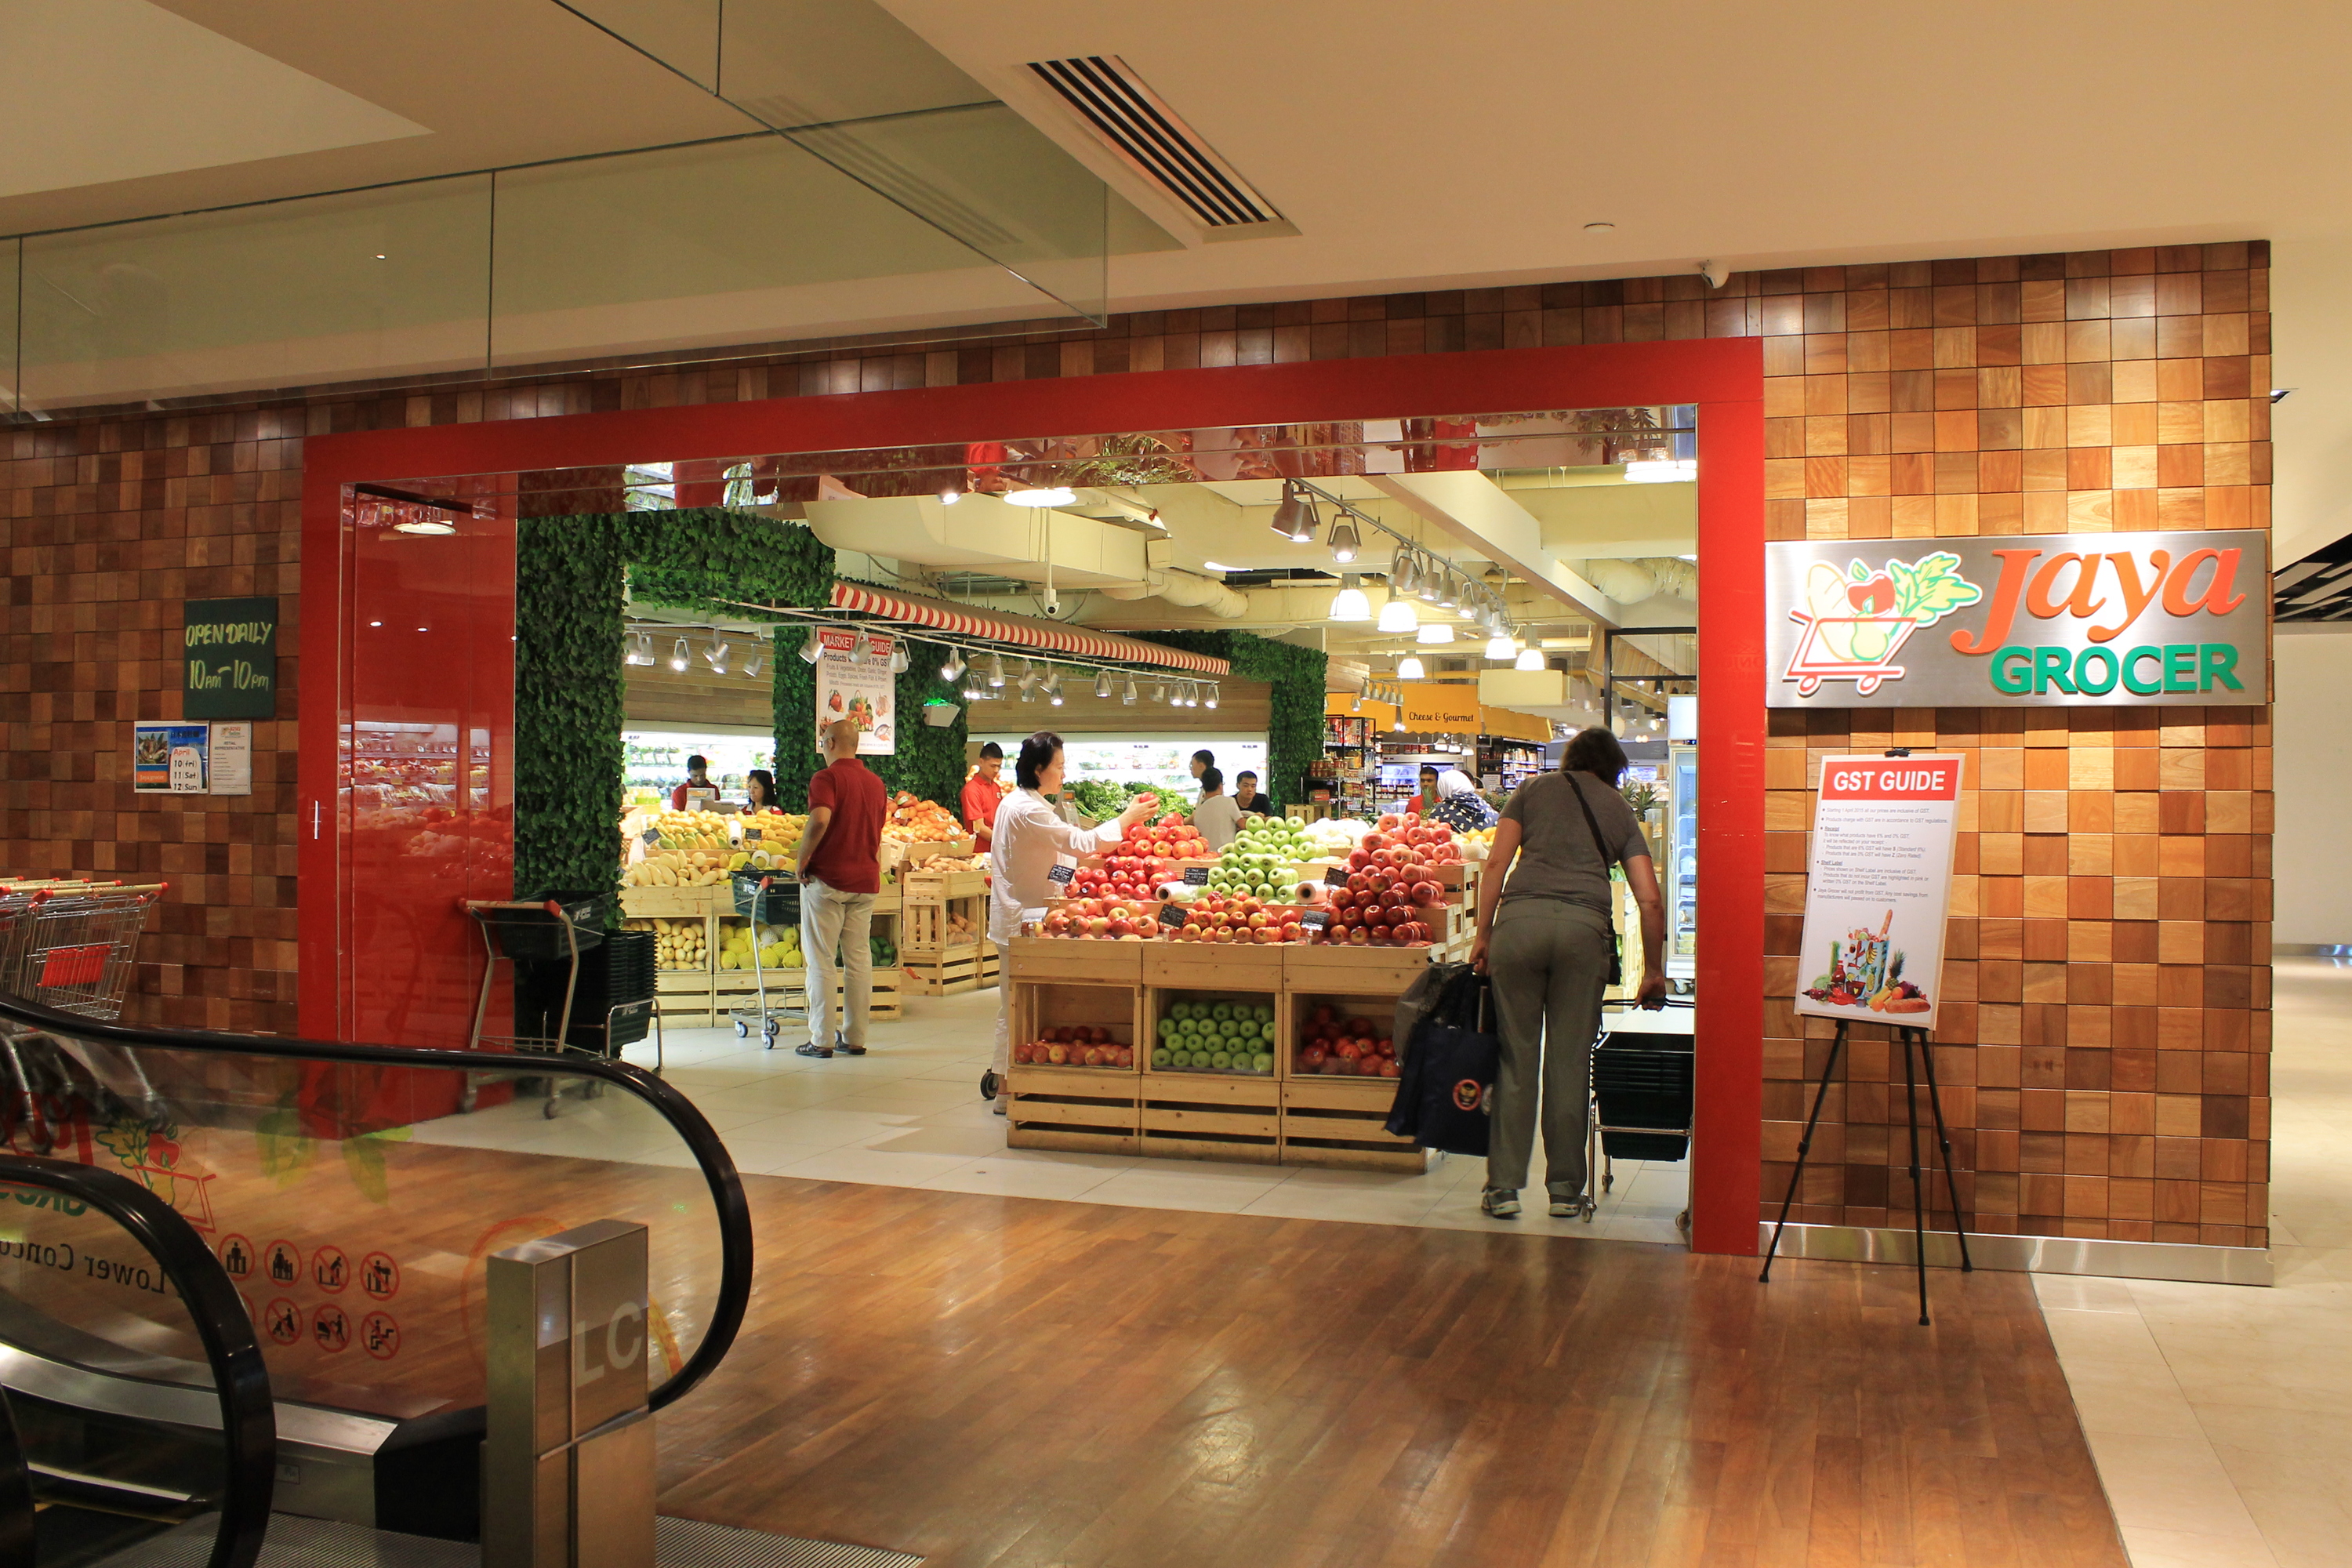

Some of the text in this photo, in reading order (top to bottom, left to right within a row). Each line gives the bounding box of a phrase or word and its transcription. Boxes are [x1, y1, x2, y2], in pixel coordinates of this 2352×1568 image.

[1950, 548, 2245, 654] Jaya
[185, 622, 272, 647] OPEN DAILY
[823, 634, 854, 648] MARKET
[871, 640, 891, 653] GUIDE
[824, 652, 847, 662] Products
[872, 657, 879, 666] 0%
[1990, 643, 2245, 695] GROCER
[1409, 711, 1474, 723] Cheese & Gourmet
[1834, 771, 1946, 791] GST GUIDE
[575, 1301, 642, 1388] LC
